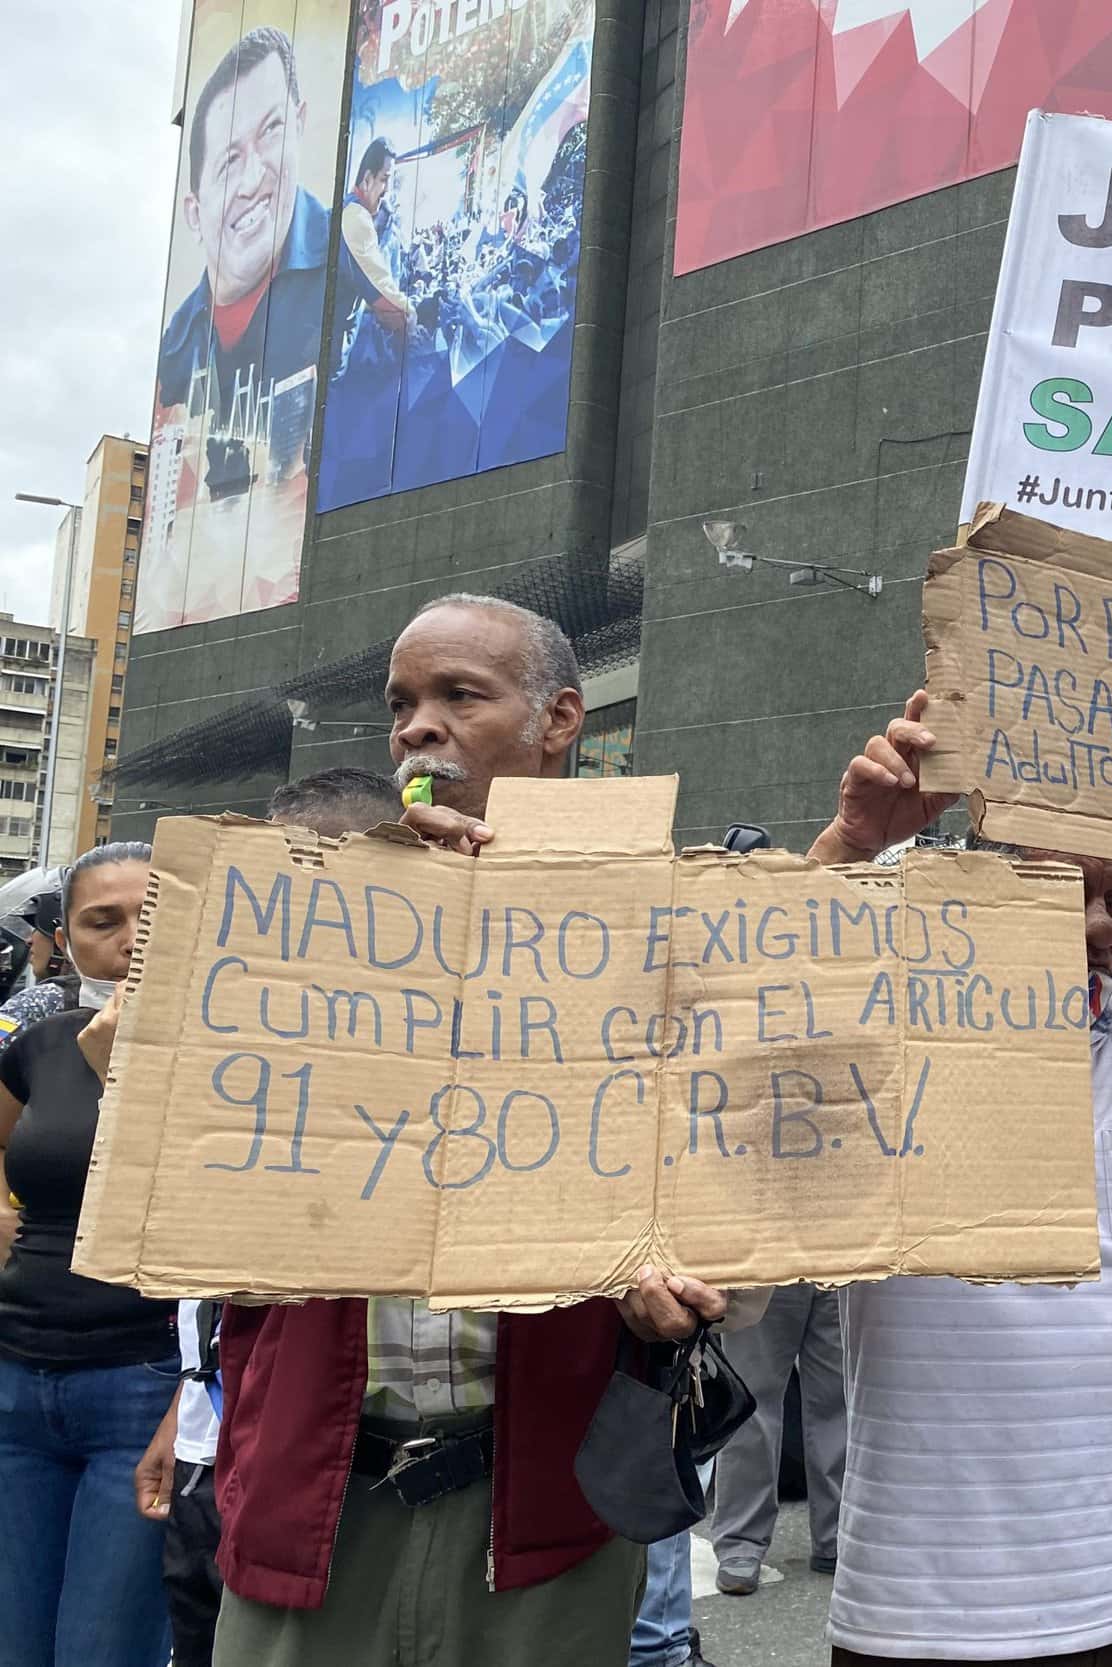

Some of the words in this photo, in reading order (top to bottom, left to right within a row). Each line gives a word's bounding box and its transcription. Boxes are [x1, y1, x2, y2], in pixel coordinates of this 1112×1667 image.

[217, 865, 611, 983] MADURO
[757, 981, 834, 1042] EL
[204, 1052, 321, 1174] 91
[422, 1083, 560, 1190] 80
[588, 1056, 931, 1177] C.R.B.V.
